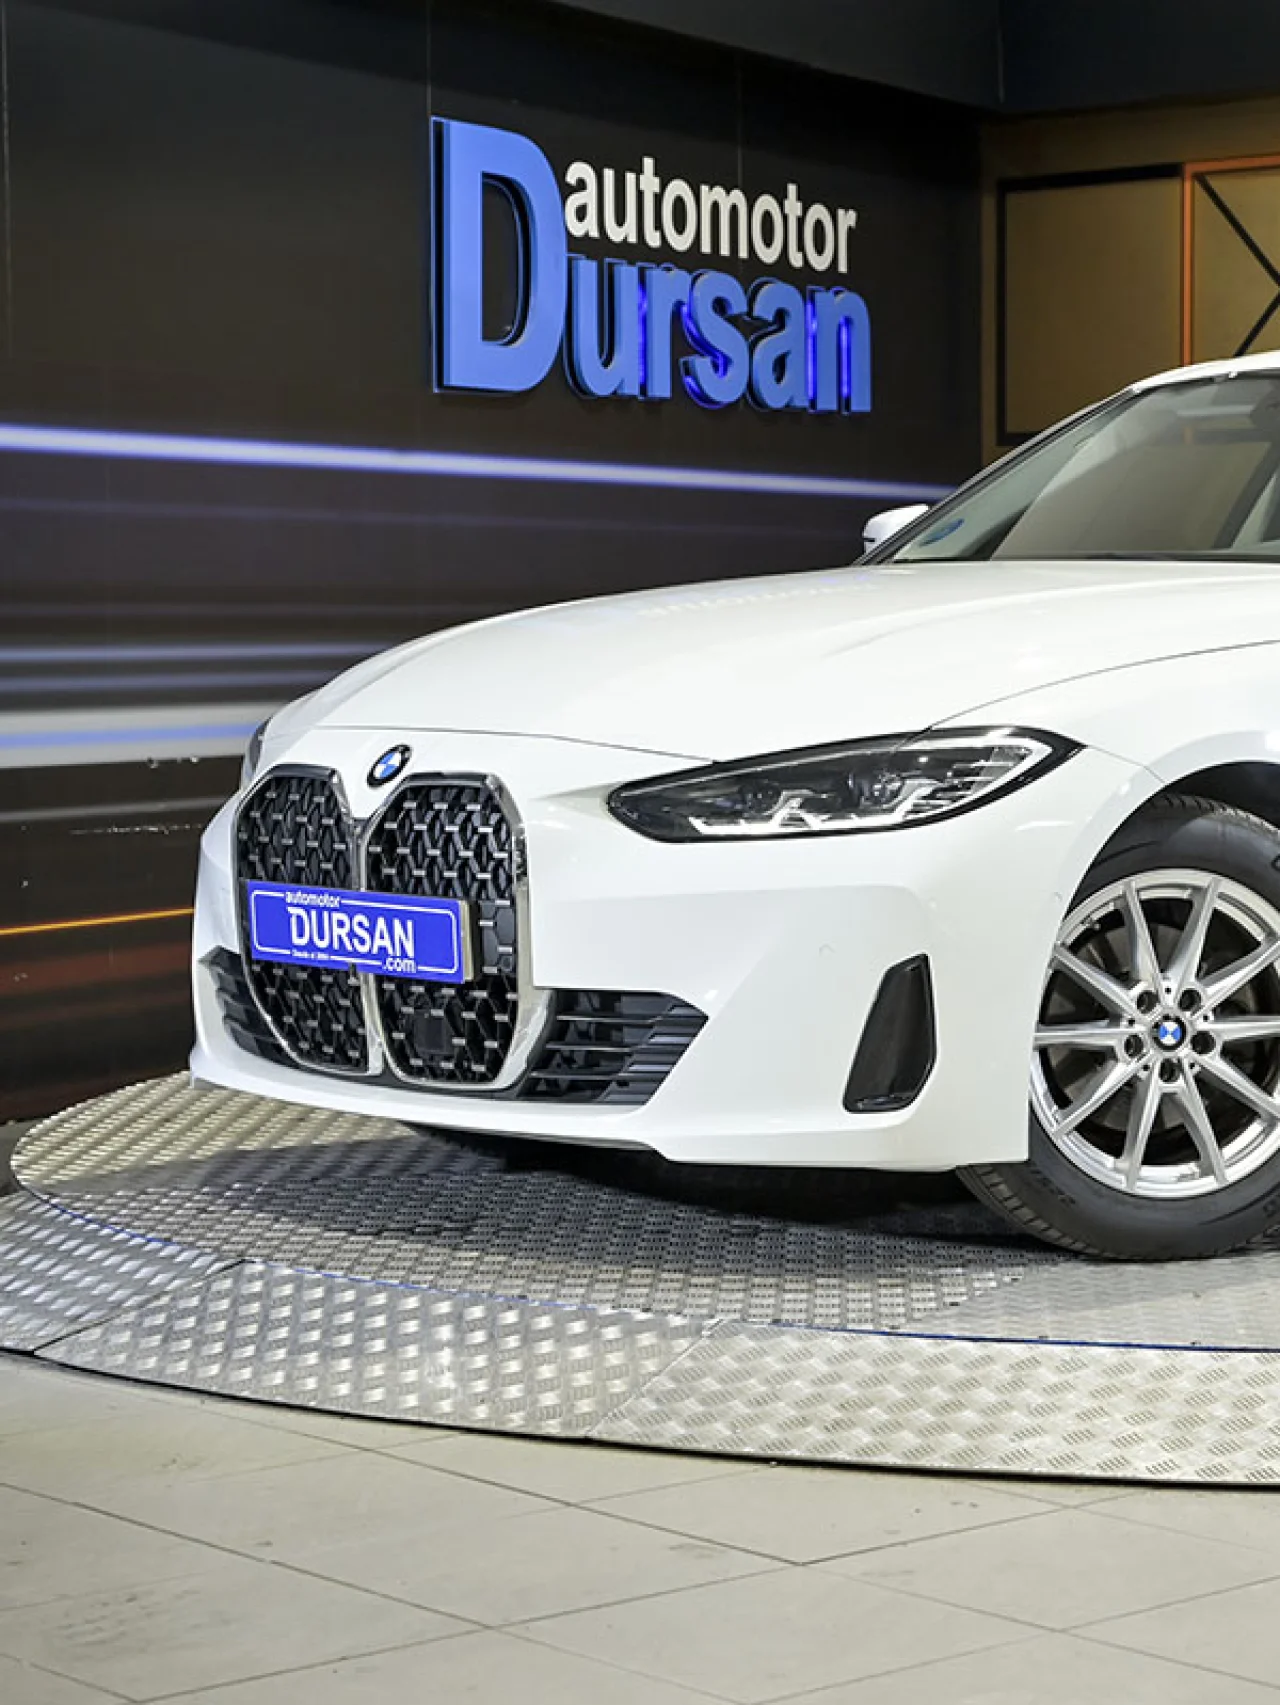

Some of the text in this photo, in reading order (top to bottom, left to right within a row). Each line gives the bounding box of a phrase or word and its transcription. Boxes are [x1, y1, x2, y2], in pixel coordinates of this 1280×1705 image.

[564, 155, 858, 273] automotor
[431, 116, 871, 414] Dursan
[285, 891, 341, 908] automotor
[287, 906, 415, 958] DURSAN
[381, 957, 417, 973] .com
